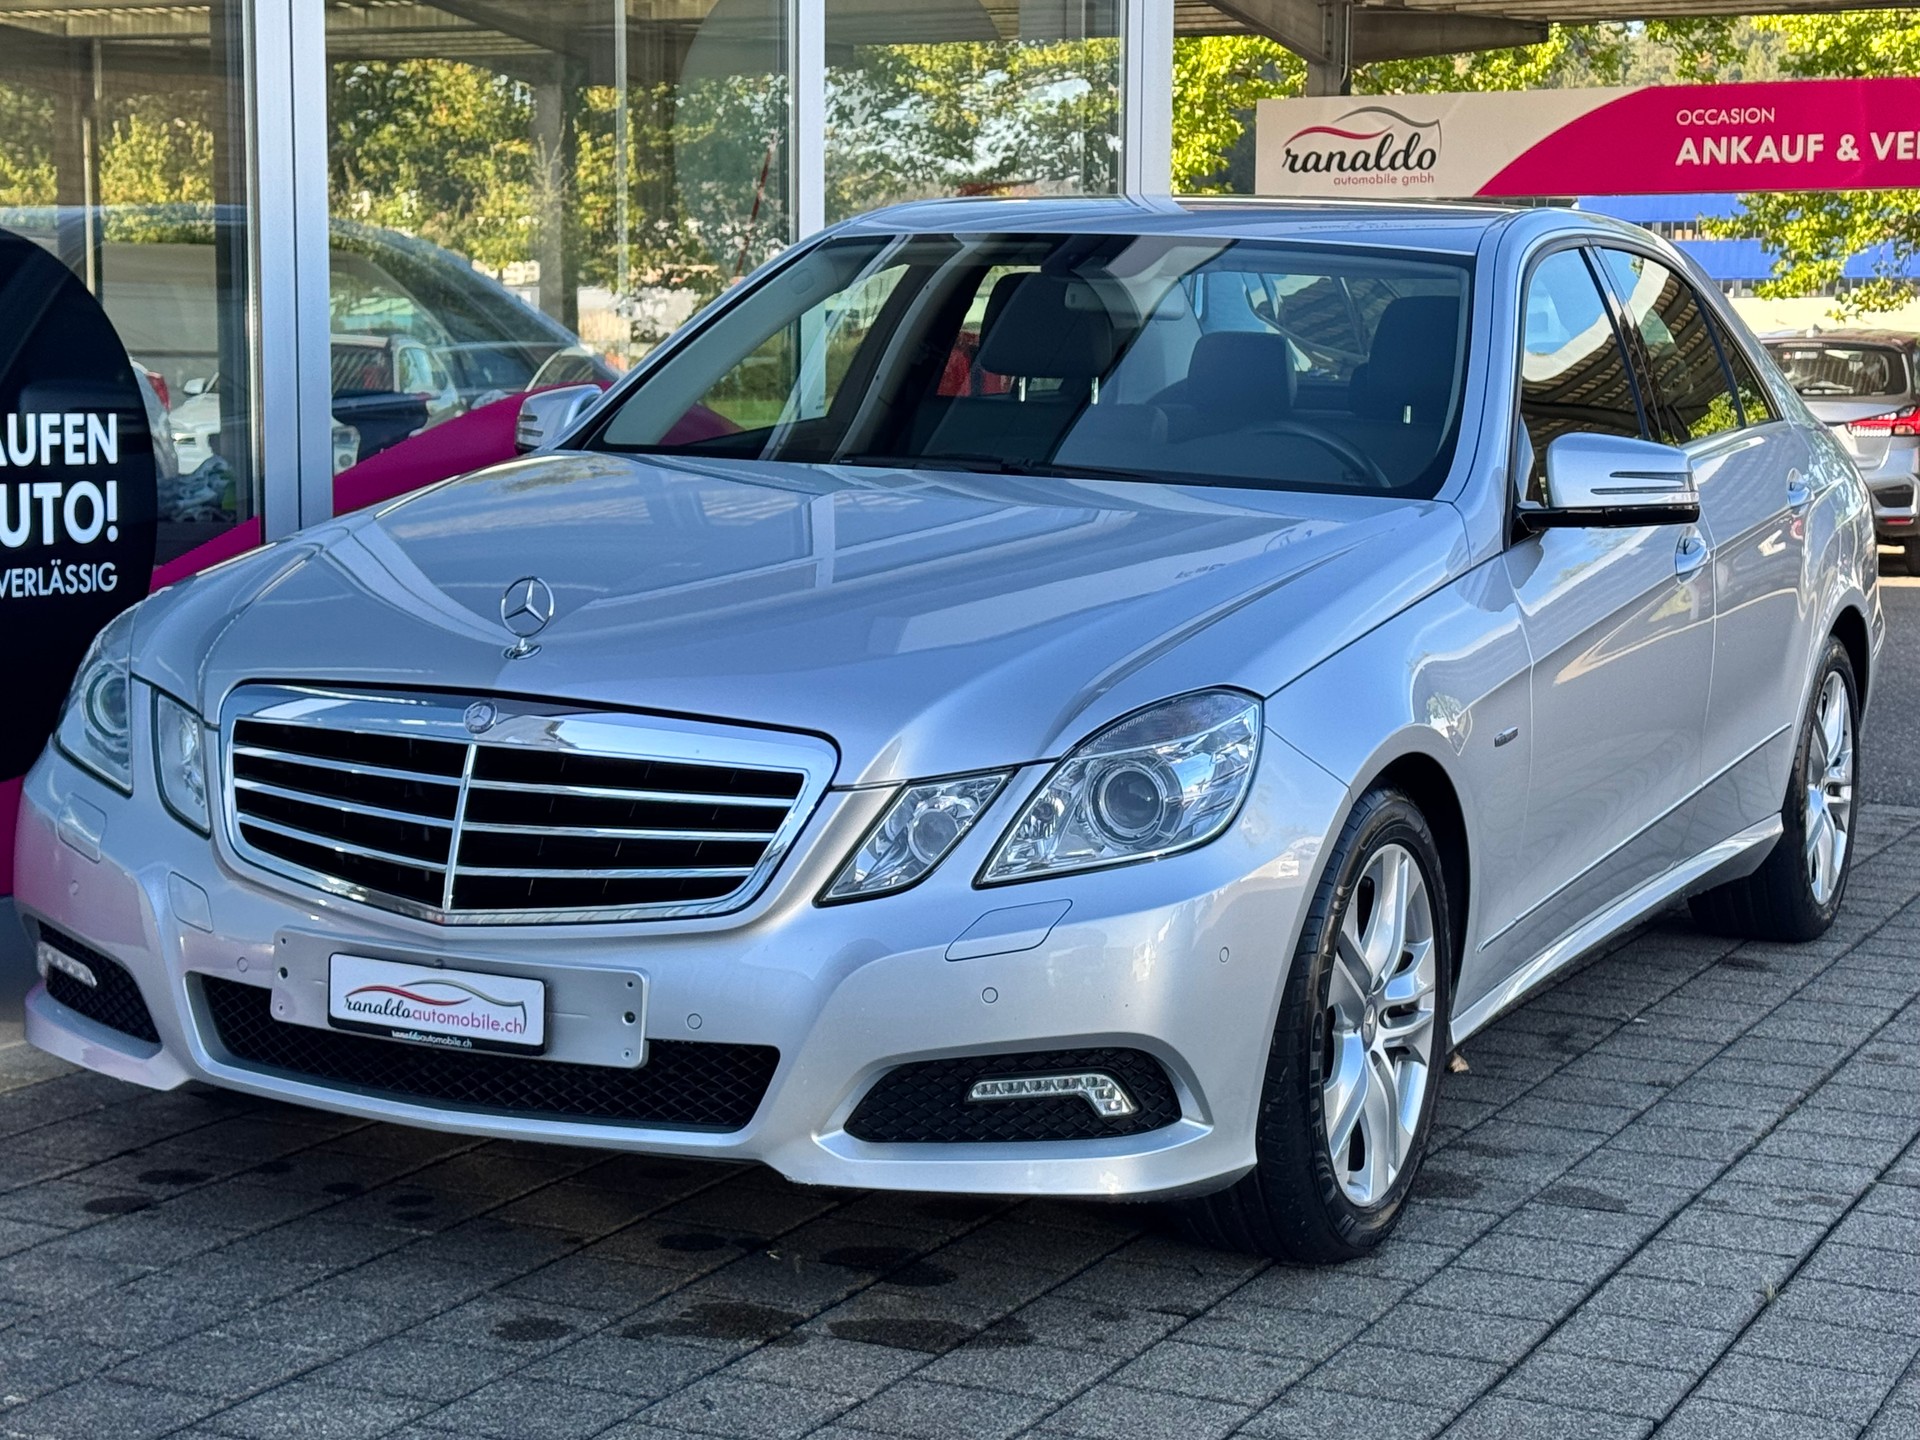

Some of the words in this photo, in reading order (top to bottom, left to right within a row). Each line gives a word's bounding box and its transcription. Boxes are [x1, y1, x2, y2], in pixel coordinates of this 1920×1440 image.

[1676, 106, 1775, 126] OCCASION
[1281, 132, 1437, 173] ranaldo
[1675, 133, 1824, 166] ANKAUF
[1836, 133, 1861, 162] &
[1870, 131, 1920, 161] VE
[1333, 173, 1398, 186] automobile
[1402, 172, 1435, 186] gmbh
[0, 412, 118, 467] UFEN
[0, 480, 119, 548] UTO!
[344, 997, 523, 1035] ranaldoautomobile.ch
